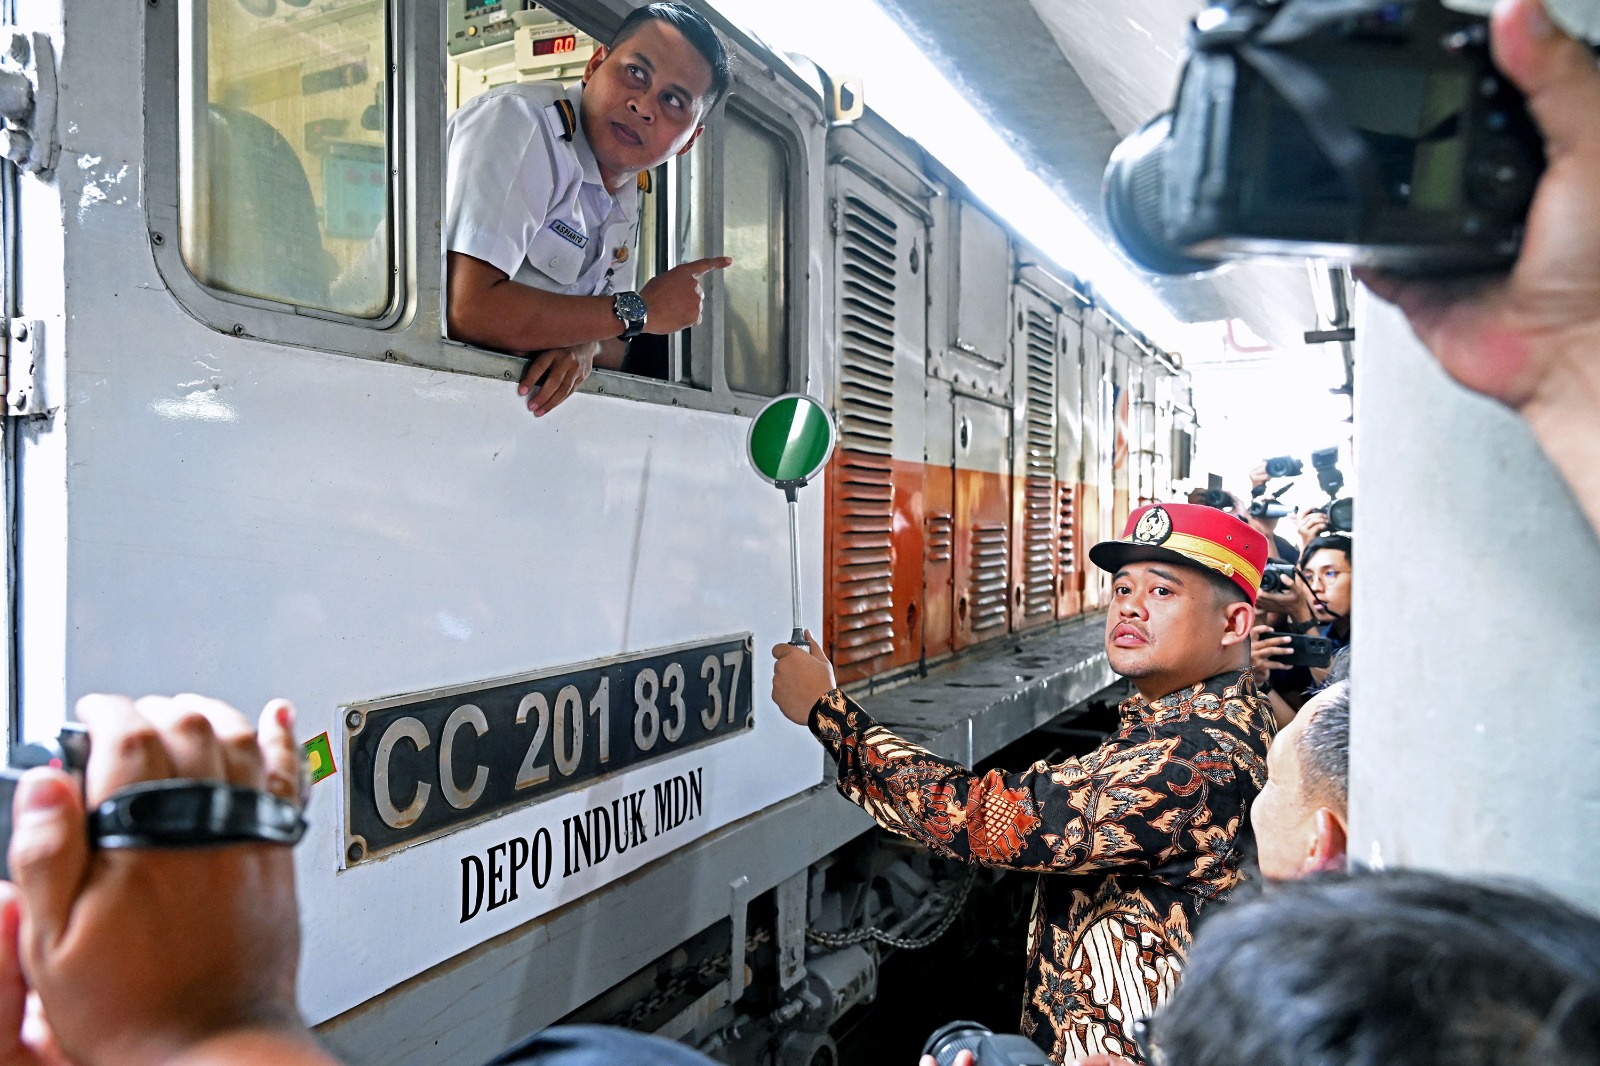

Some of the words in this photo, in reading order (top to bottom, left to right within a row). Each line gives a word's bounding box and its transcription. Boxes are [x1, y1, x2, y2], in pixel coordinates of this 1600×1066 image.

[554, 37, 575, 53] 0.0
[373, 703, 490, 830] CC
[514, 676, 611, 791] 201
[633, 662, 687, 751] 83
[700, 650, 744, 731] 37
[459, 827, 553, 924] DEPO
[562, 789, 648, 878] INDUK
[654, 767, 704, 838] MDN
